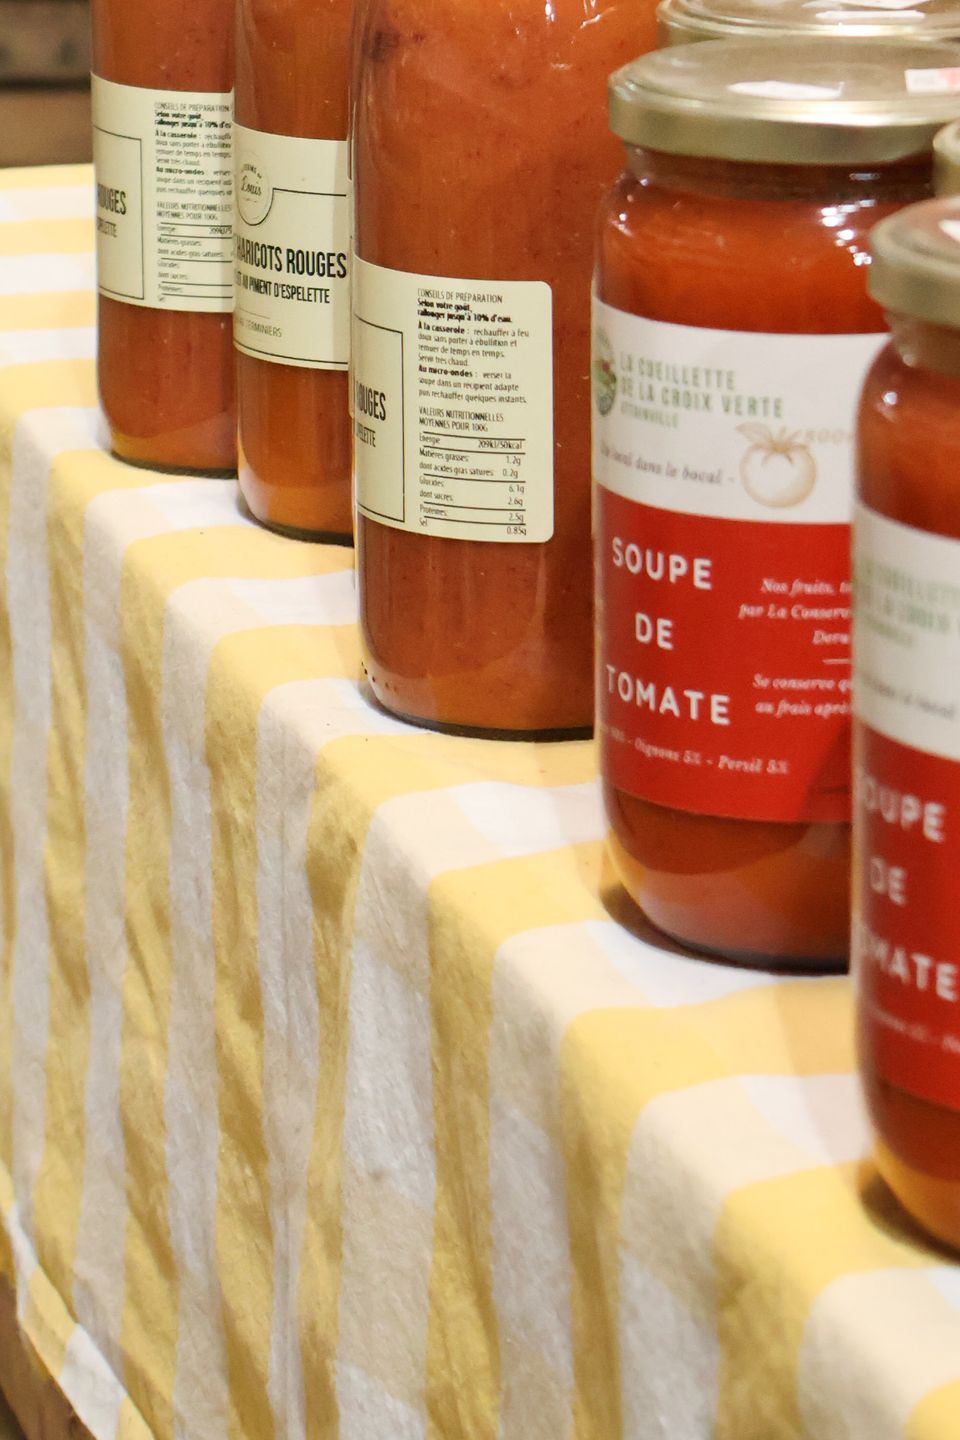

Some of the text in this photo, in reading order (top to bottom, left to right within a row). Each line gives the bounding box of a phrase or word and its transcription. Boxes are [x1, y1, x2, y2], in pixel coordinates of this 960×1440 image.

[286, 248, 347, 279] ROUGES
[249, 276, 273, 297] PIMENT
[274, 281, 331, 304] D'ESPELETTE
[417, 288, 445, 300] CONSEILS
[446, 291, 454, 300] DE
[473, 313, 490, 322] 10%
[431, 323, 465, 334] casserole
[418, 364, 428, 373] Au
[428, 366, 473, 377] micro-ondes
[620, 352, 737, 390] LA CUEILLETTE
[639, 382, 654, 402] LA
[660, 385, 712, 412] CROIX
[721, 395, 784, 419] VERTE
[419, 407, 504, 422] VALEURS NUTRITIONNELLES
[419, 418, 450, 429] MOYENNES
[451, 421, 470, 431] POUR
[611, 536, 713, 591] SOUPE
[760, 577, 788, 594] Nos
[767, 603, 787, 619] La
[634, 611, 674, 651] DE
[605, 663, 731, 726] TOMATE
